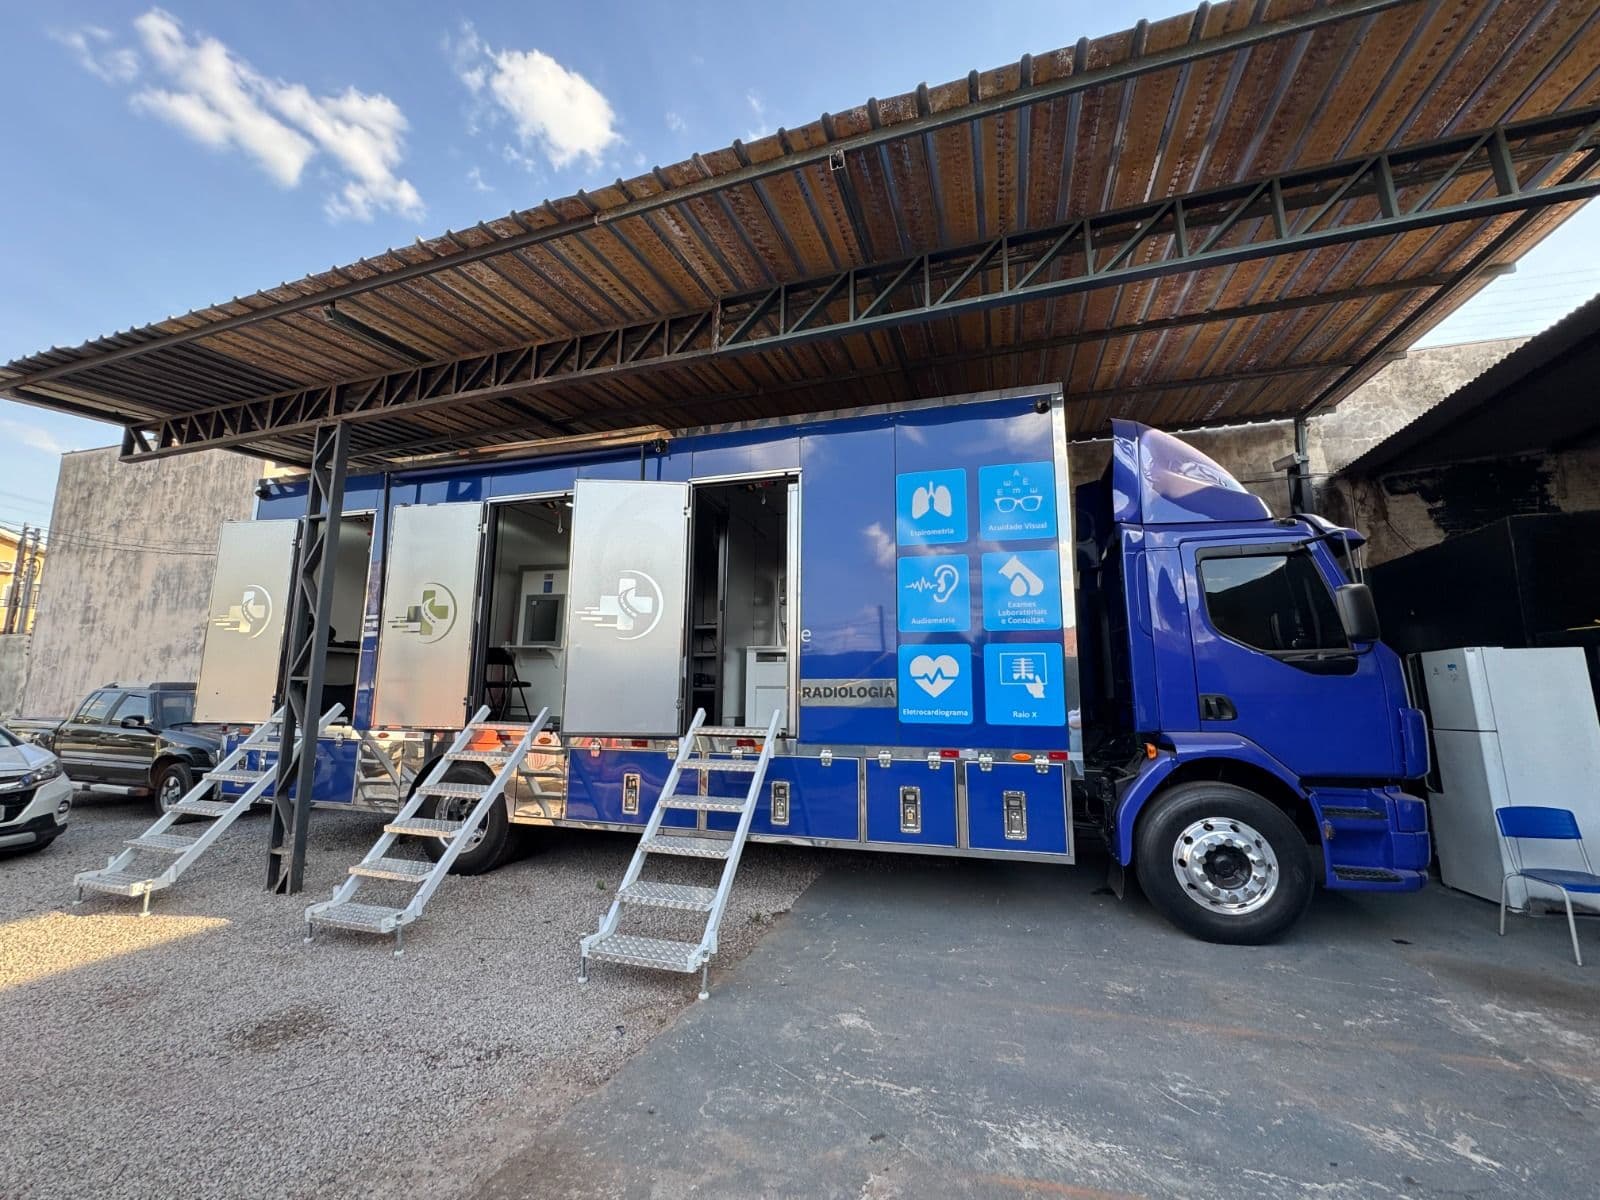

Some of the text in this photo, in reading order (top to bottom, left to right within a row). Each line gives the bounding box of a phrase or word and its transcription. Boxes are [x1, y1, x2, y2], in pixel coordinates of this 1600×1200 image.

[1024, 521, 1047, 529] Visual
[910, 527, 954, 537] Espirometria
[911, 617, 955, 625] Audiometria
[802, 687, 895, 698] RADIOLOGIA
[903, 709, 968, 719] Eletrocardiograma
[1013, 711, 1030, 719] Raio
